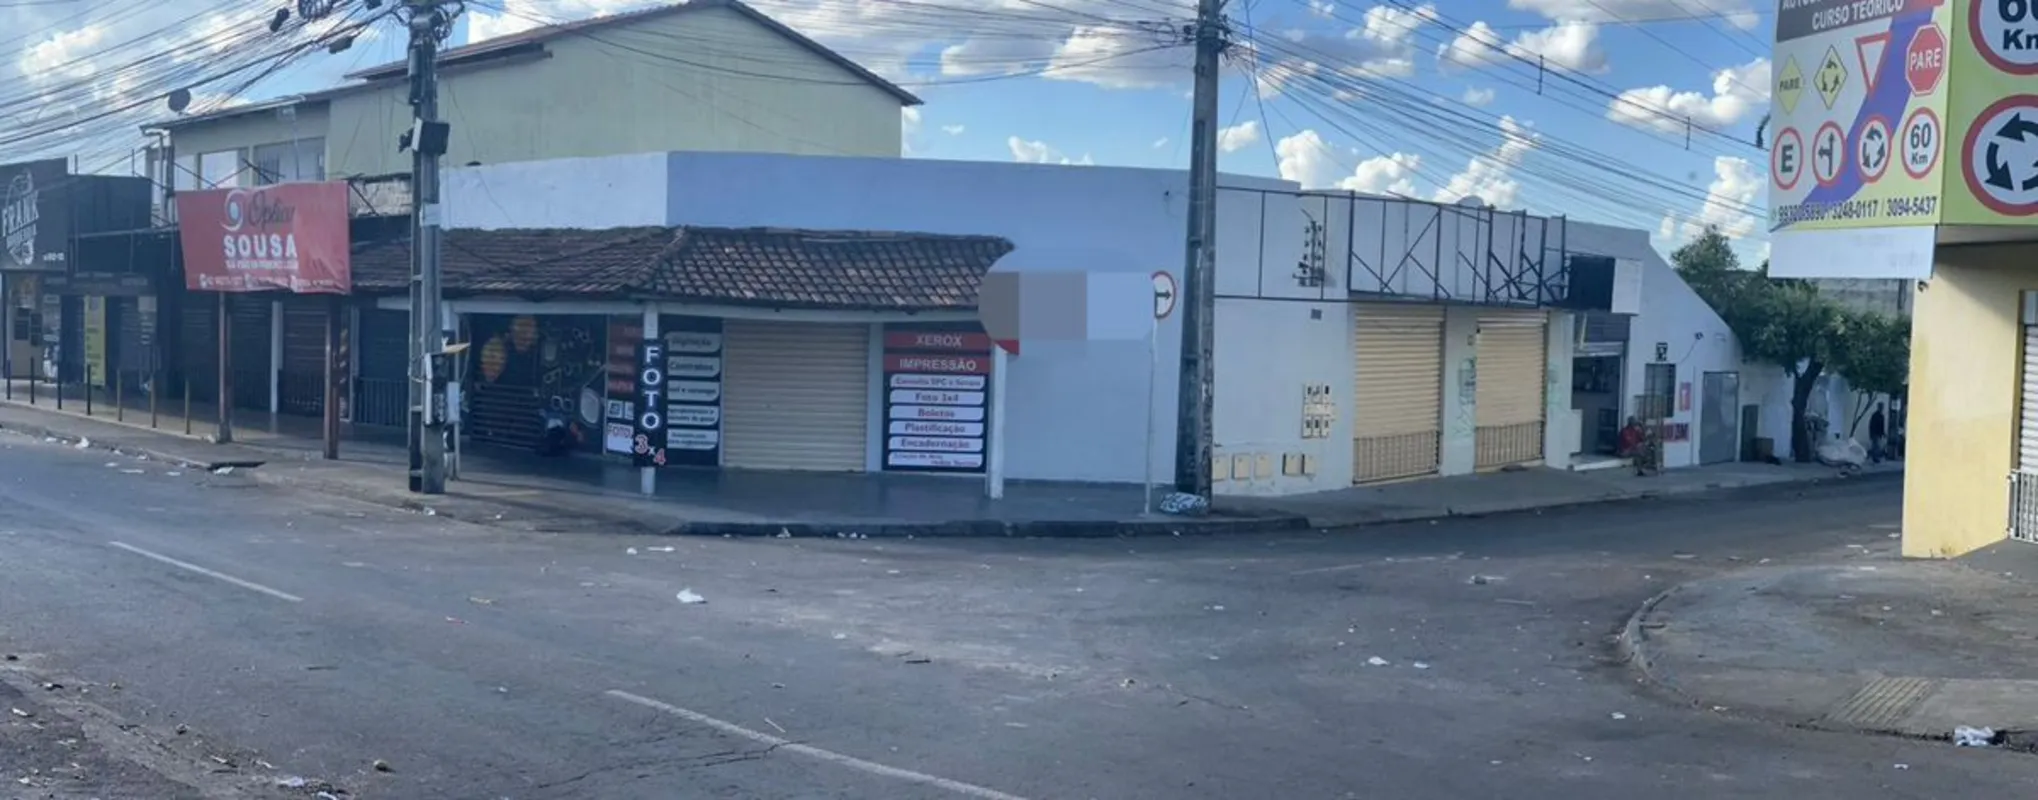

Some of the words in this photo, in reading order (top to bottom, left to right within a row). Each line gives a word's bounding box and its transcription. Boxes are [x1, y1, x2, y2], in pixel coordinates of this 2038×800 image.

[1812, 5, 1850, 31] CURSO
[1910, 48, 1942, 71] PARE
[1779, 77, 1800, 92] PARE
[1910, 123, 1931, 150] 60
[1780, 145, 1794, 173] E
[1911, 152, 1929, 165] Km
[223, 233, 298, 258] SOUSA
[916, 334, 963, 348] XEROX
[899, 357, 977, 371] IMPRESSÃO
[643, 345, 661, 429] FOTO
